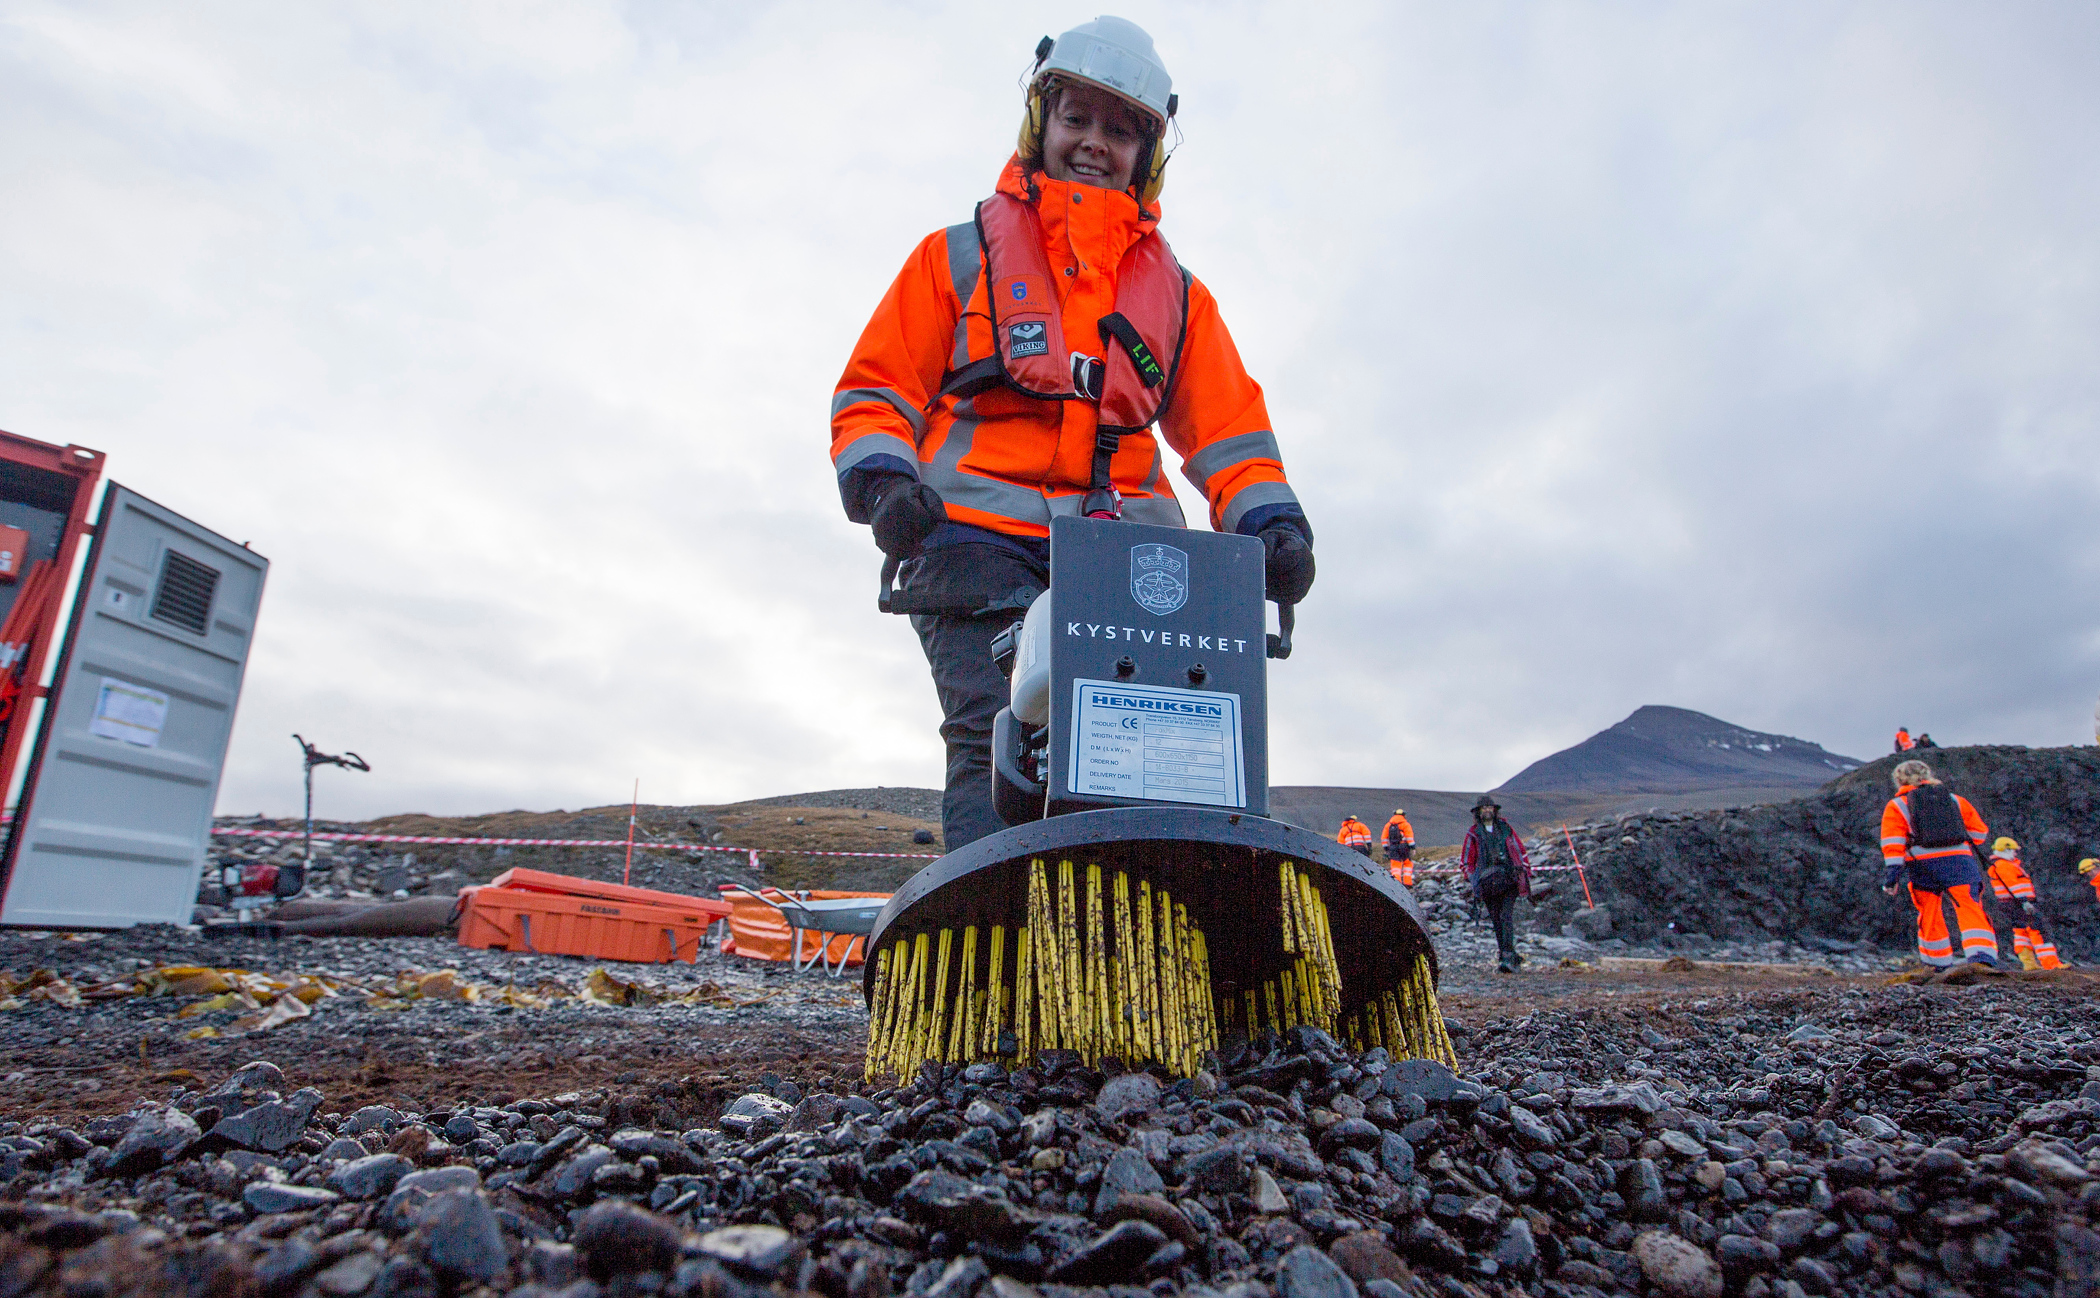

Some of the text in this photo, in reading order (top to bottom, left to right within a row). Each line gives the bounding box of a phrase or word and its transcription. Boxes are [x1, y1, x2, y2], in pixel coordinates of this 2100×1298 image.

[1013, 341, 1045, 352] VIKING
[1132, 343, 1164, 385] LIF
[1067, 622, 1247, 653] KYSTVERKET
[1092, 695, 1221, 715] HENRIKSEN
[1091, 720, 1117, 728] PRODUCT
[1121, 717, 1138, 730] CE
[1089, 771, 1116, 779] DELIVERY
[1088, 784, 1116, 792] REMARKS
[1174, 778, 1189, 787] 2015
